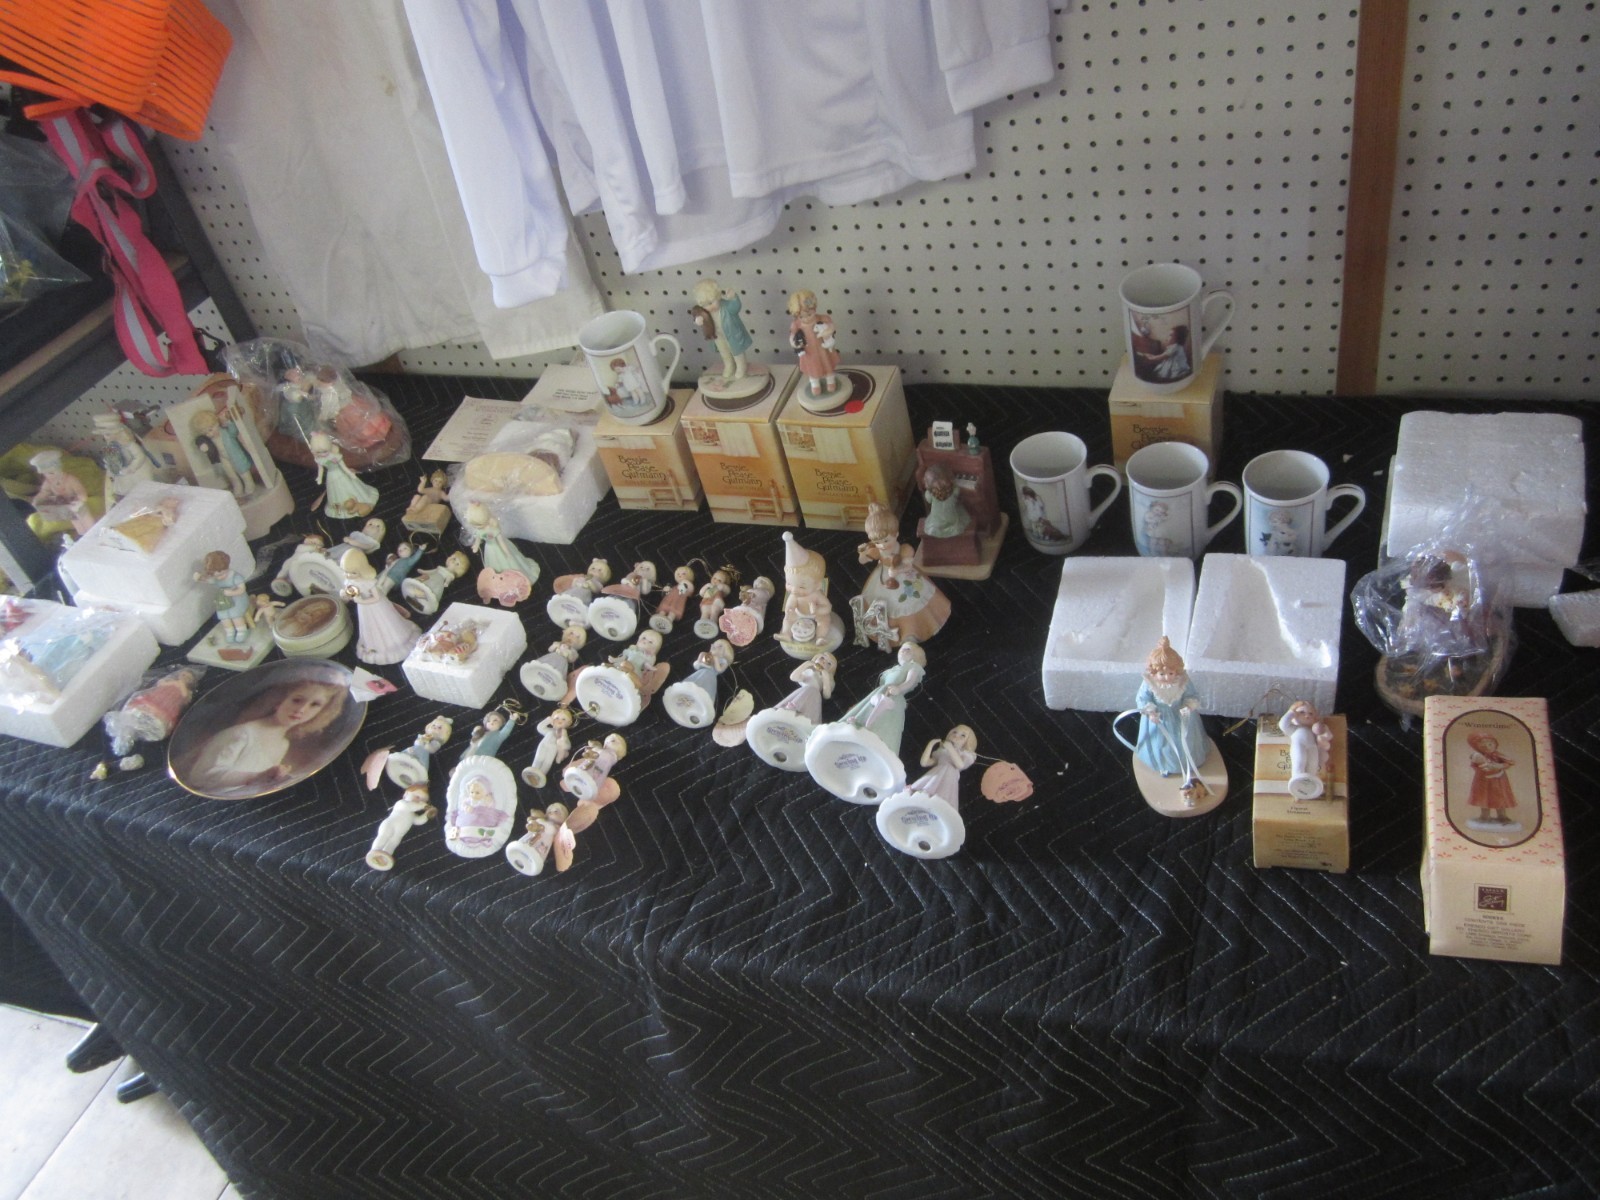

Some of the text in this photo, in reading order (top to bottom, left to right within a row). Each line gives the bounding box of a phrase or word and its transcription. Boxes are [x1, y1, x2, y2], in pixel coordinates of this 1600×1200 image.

[627, 463, 659, 473] Pease
[621, 469, 667, 481] Gutmann
[727, 469, 757, 479] Pease
[722, 475, 763, 487] Gutmann
[822, 476, 853, 486] Pease
[816, 481, 859, 494] Gutmann
